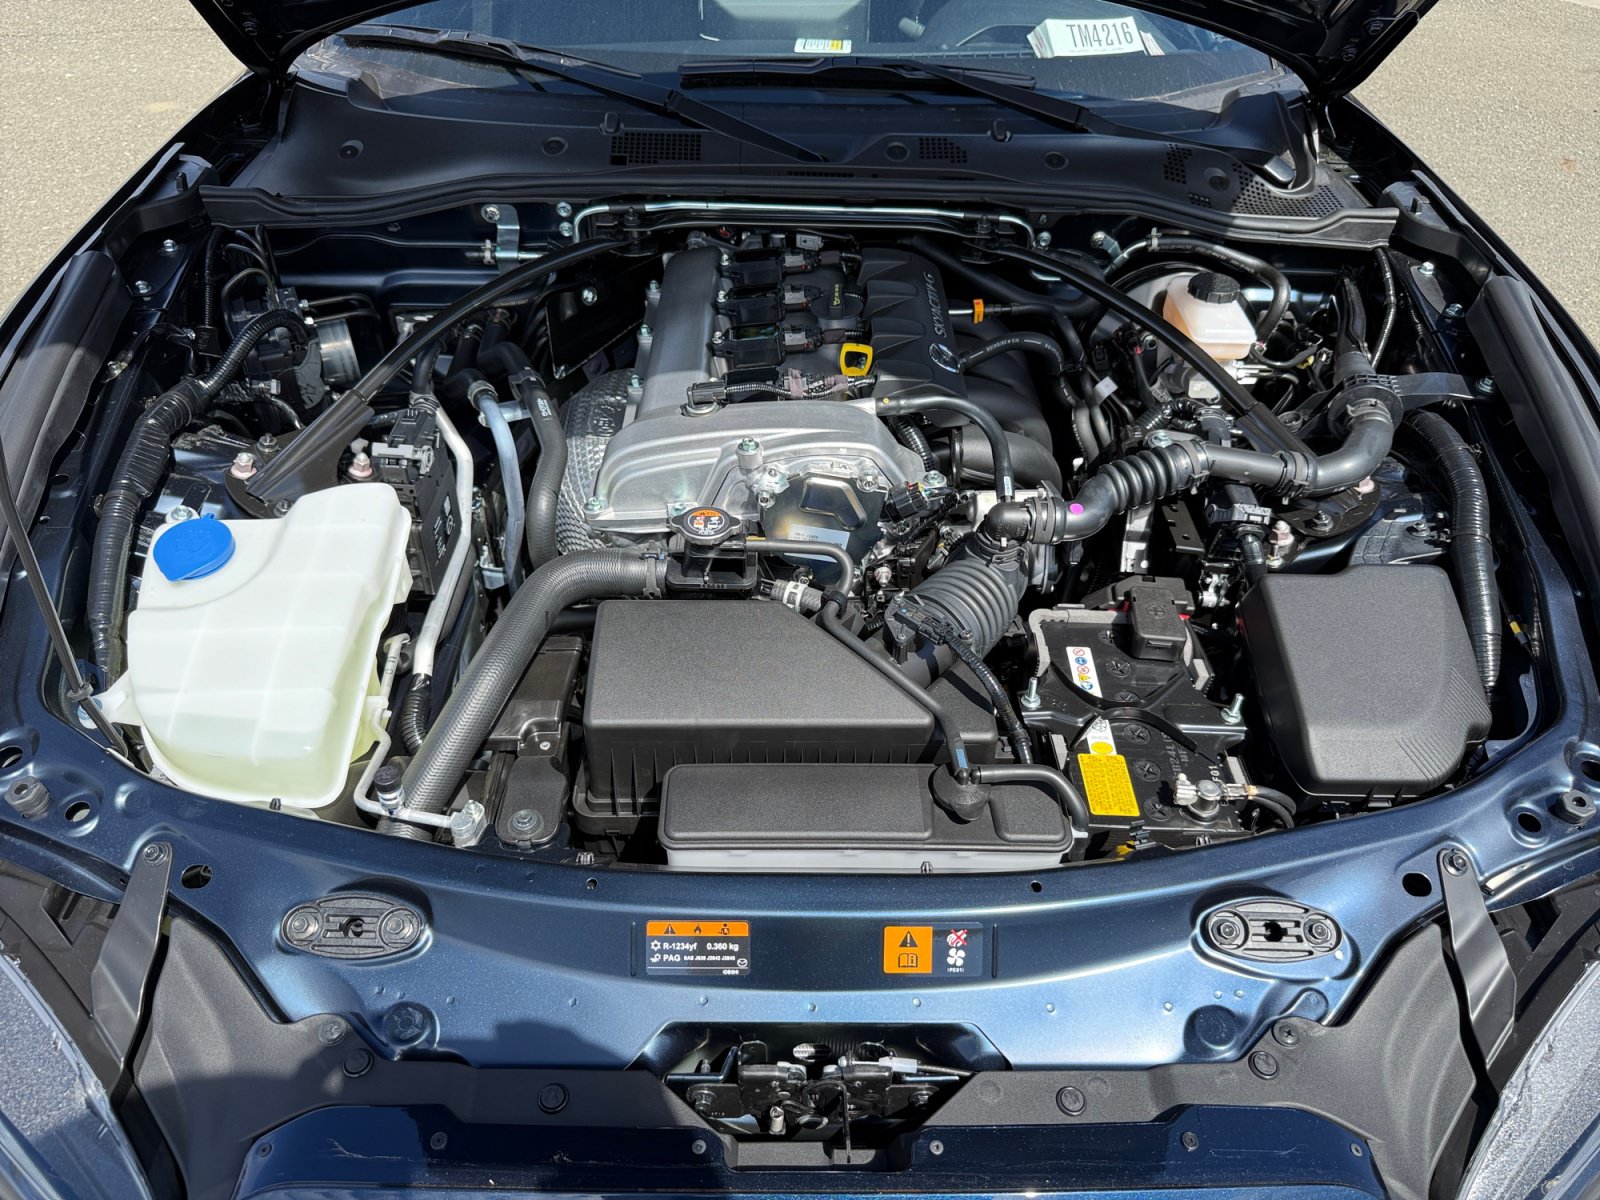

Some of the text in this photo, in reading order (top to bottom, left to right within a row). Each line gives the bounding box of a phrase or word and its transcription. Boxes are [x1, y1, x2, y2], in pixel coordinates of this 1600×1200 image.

[1066, 21, 1134, 48] TM4216
[663, 942, 698, 952] R-1234yf
[729, 942, 739, 952] kg
[663, 954, 681, 962] PAG
